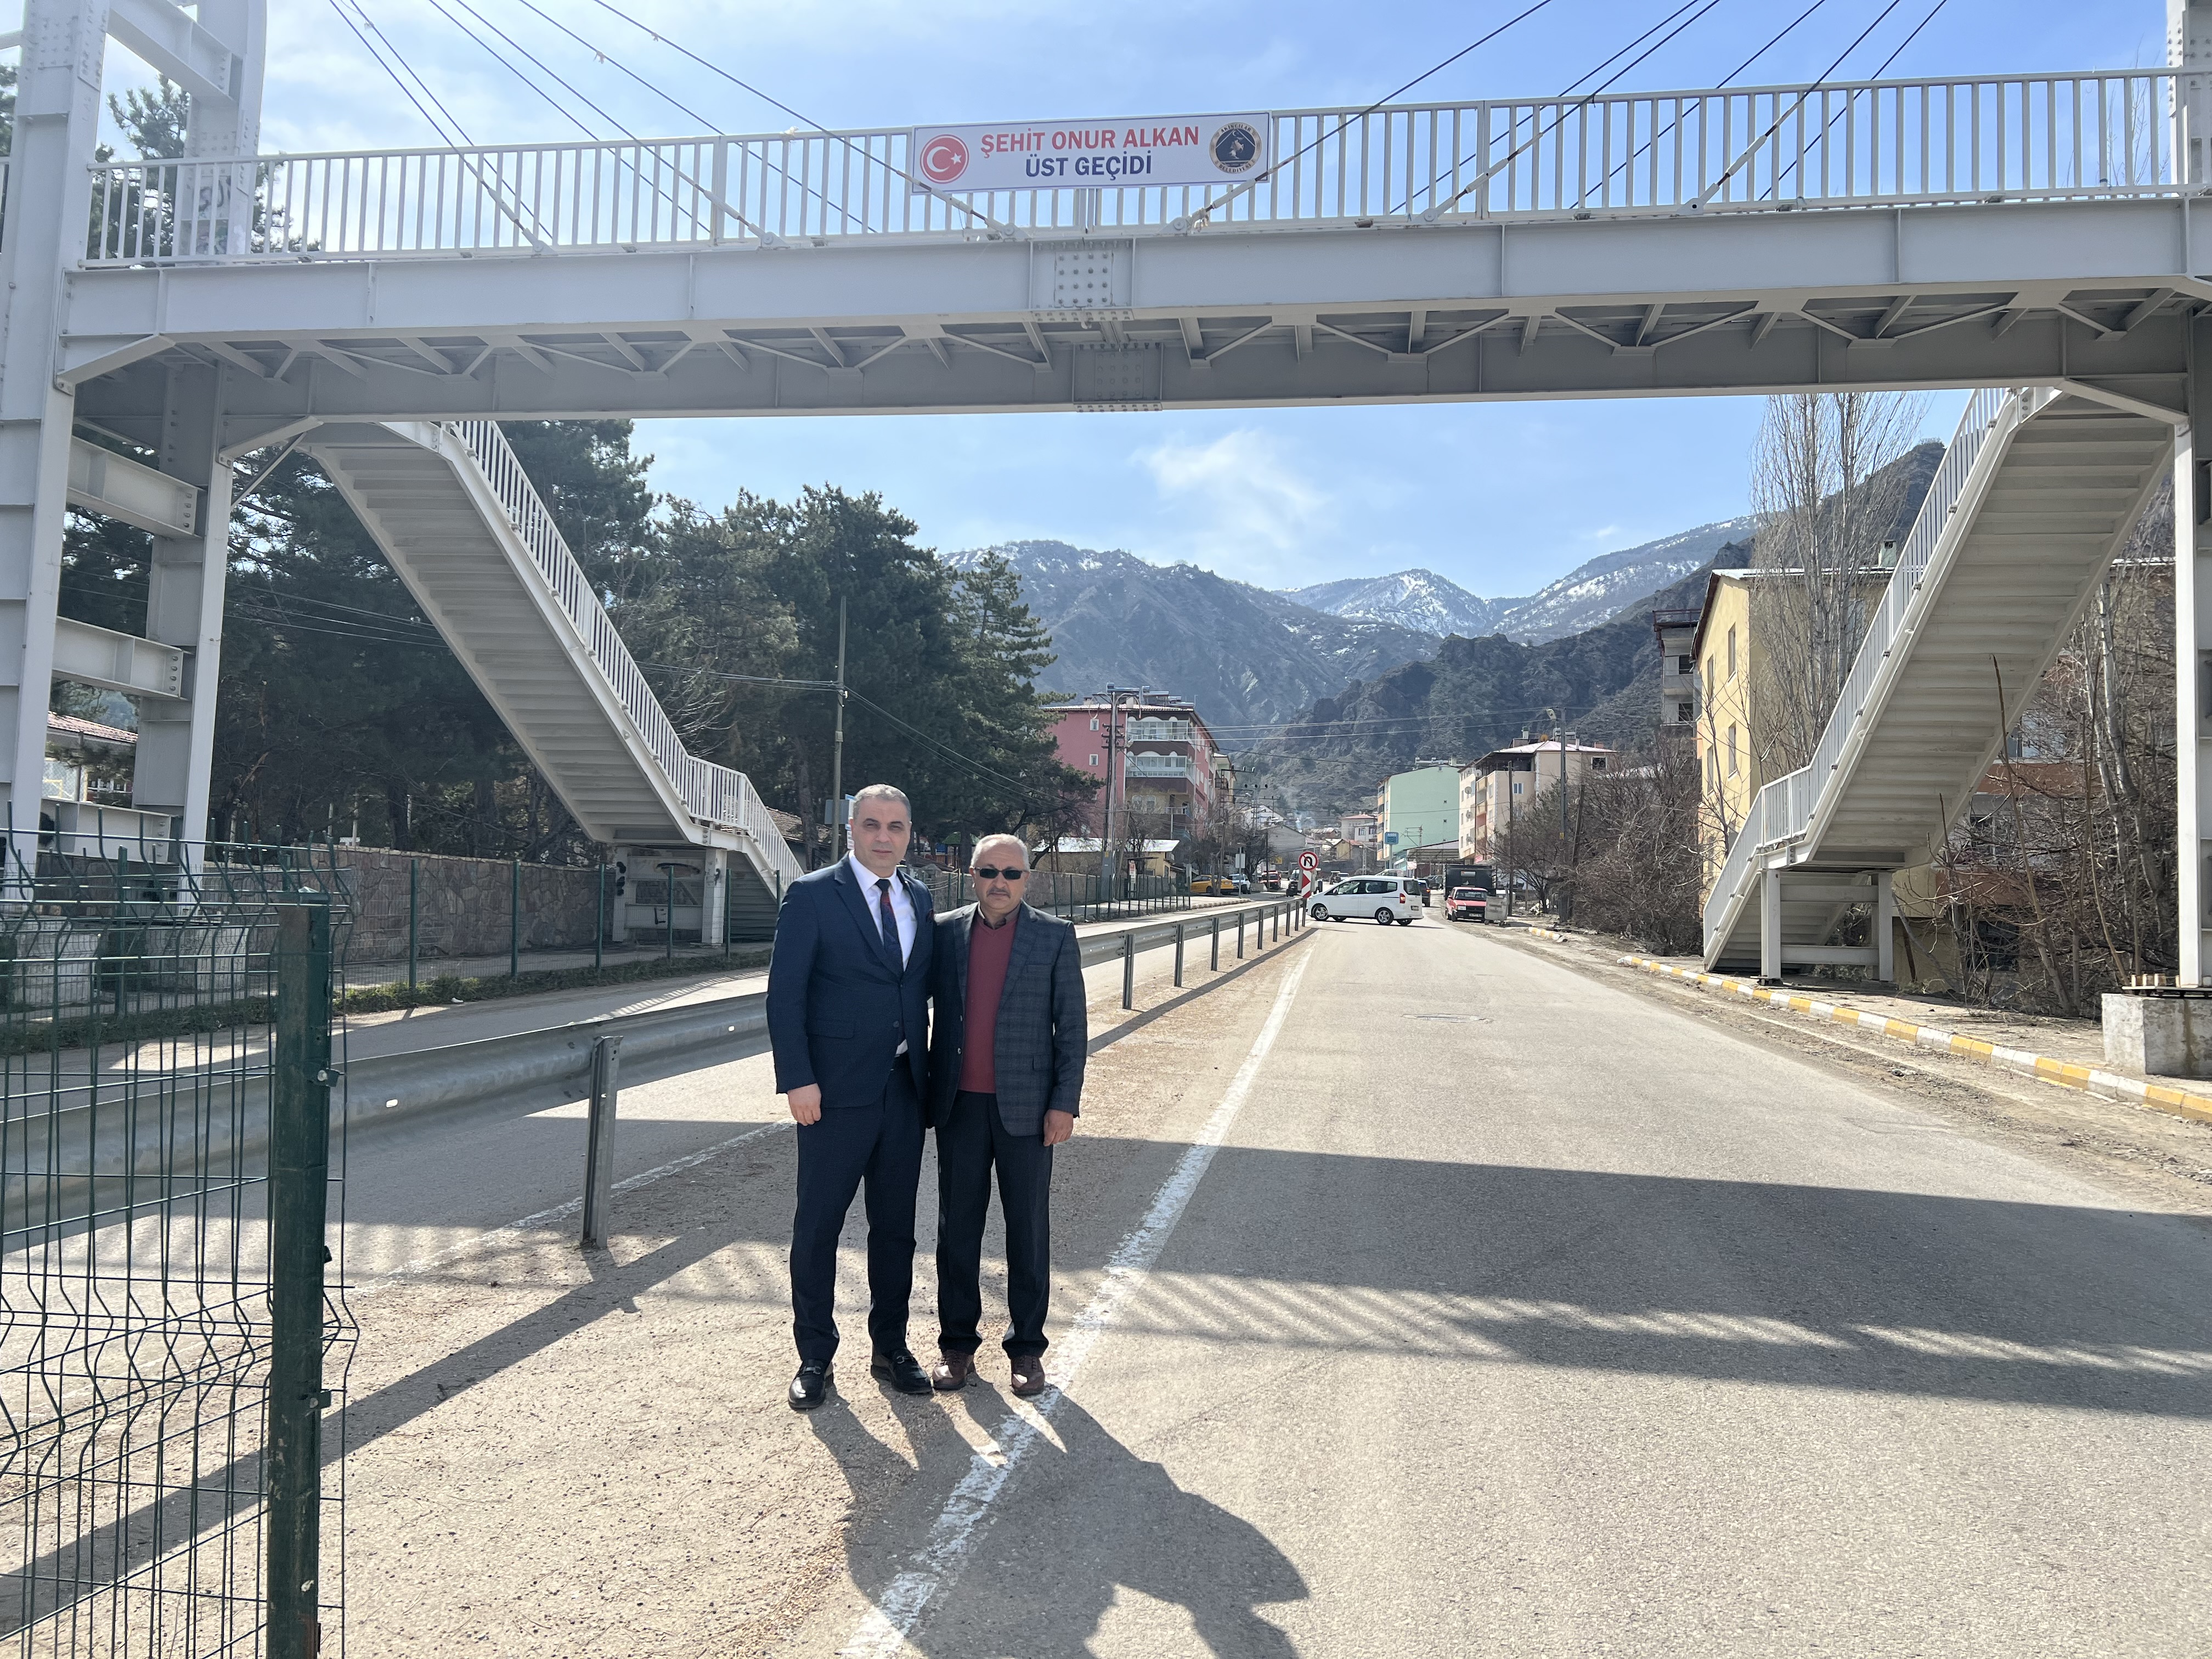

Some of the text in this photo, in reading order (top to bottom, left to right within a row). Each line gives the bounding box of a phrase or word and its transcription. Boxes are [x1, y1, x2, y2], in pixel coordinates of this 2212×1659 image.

[980, 126, 1199, 159] ŞEHİT ONUR ALKAN
[1026, 150, 1152, 180] ÜST GEÇİDİ
